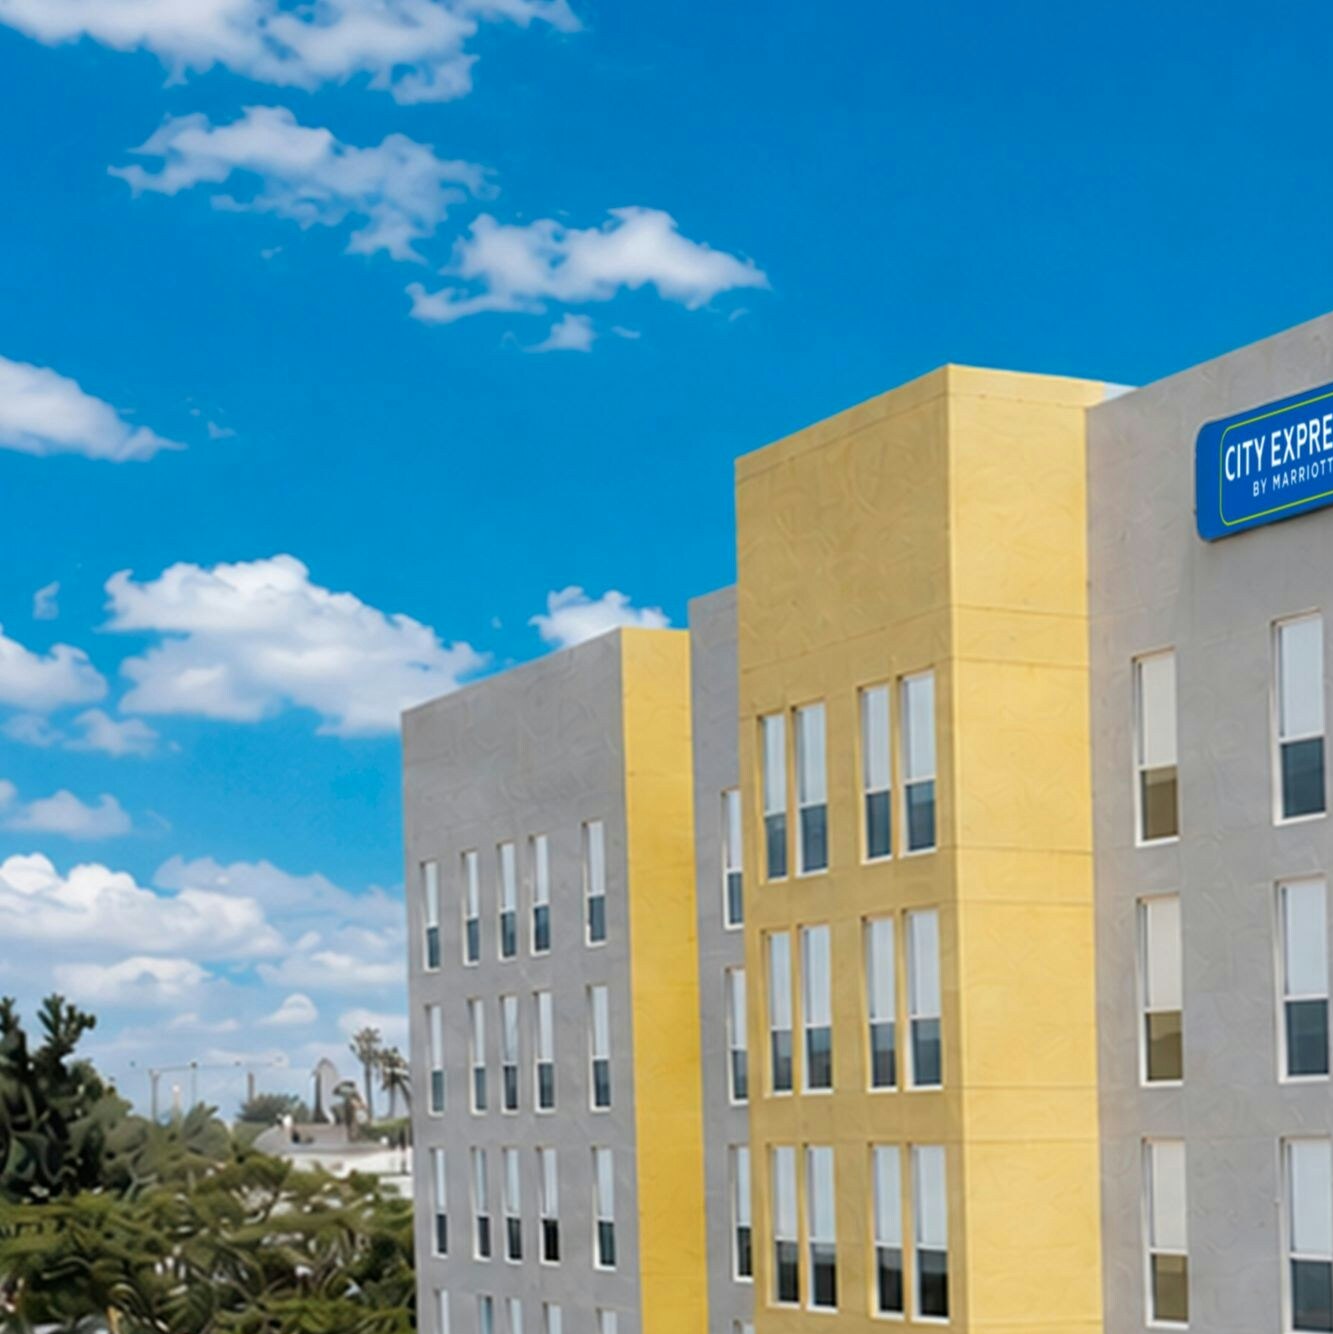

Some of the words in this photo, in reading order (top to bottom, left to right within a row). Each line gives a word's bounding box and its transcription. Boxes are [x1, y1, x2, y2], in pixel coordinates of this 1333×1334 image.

[1224, 435, 1265, 481] CITY
[1253, 479, 1267, 497] BY
[1272, 456, 1333, 491] MARRIOTT
